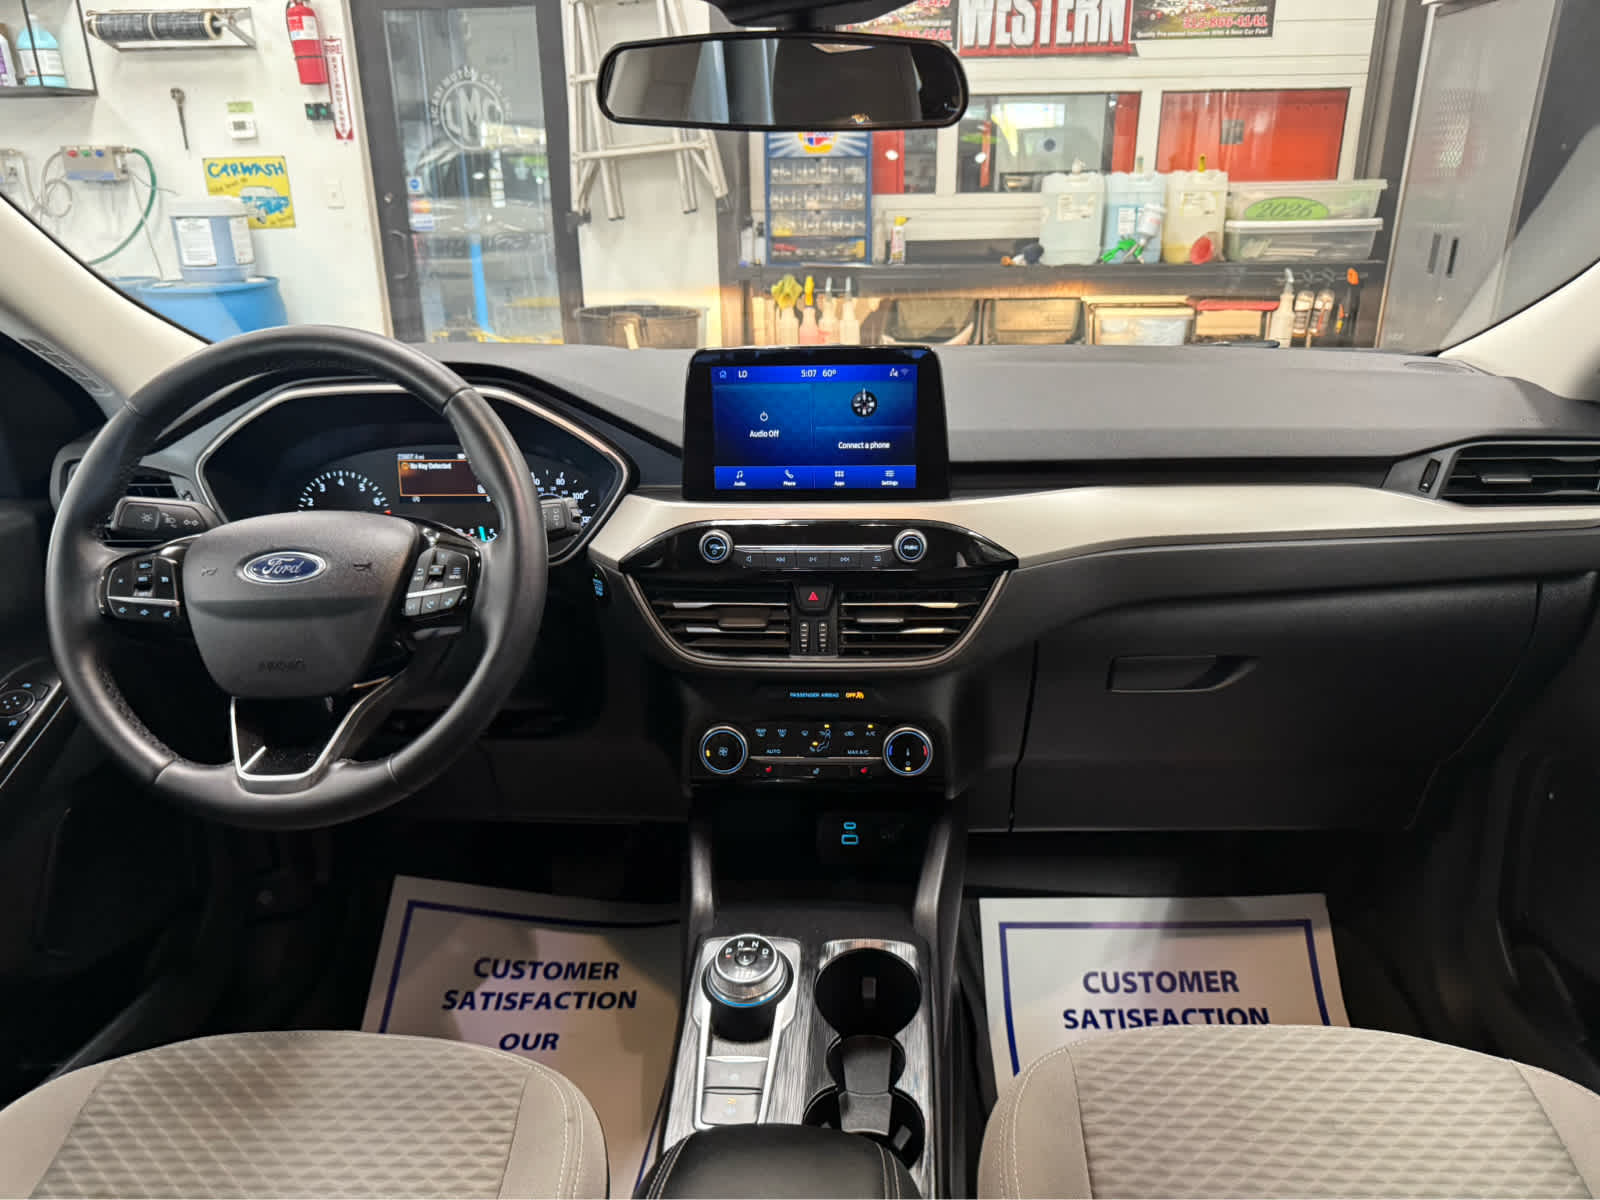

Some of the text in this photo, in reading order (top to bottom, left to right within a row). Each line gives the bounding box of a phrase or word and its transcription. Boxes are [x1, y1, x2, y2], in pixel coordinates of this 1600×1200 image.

[959, 0, 1127, 48] WESTERN
[800, 369, 817, 377] 5:07
[749, 429, 779, 438] Audio Off
[838, 441, 864, 449] Connect
[869, 441, 891, 450] phone
[337, 478, 345, 487] 4
[555, 478, 566, 486] 80
[319, 483, 326, 492] 3
[358, 483, 366, 492] 5
[307, 497, 314, 506] 2
[373, 497, 381, 506] 6
[261, 558, 305, 575] Ford
[725, 947, 733, 955] P
[473, 957, 620, 981] CUSTOMER
[1082, 970, 1240, 994] CUSTOMER
[441, 989, 638, 1011] SATISFACTION
[1062, 1006, 1270, 1030] SATISFACTION
[499, 1033, 560, 1051] OUR
